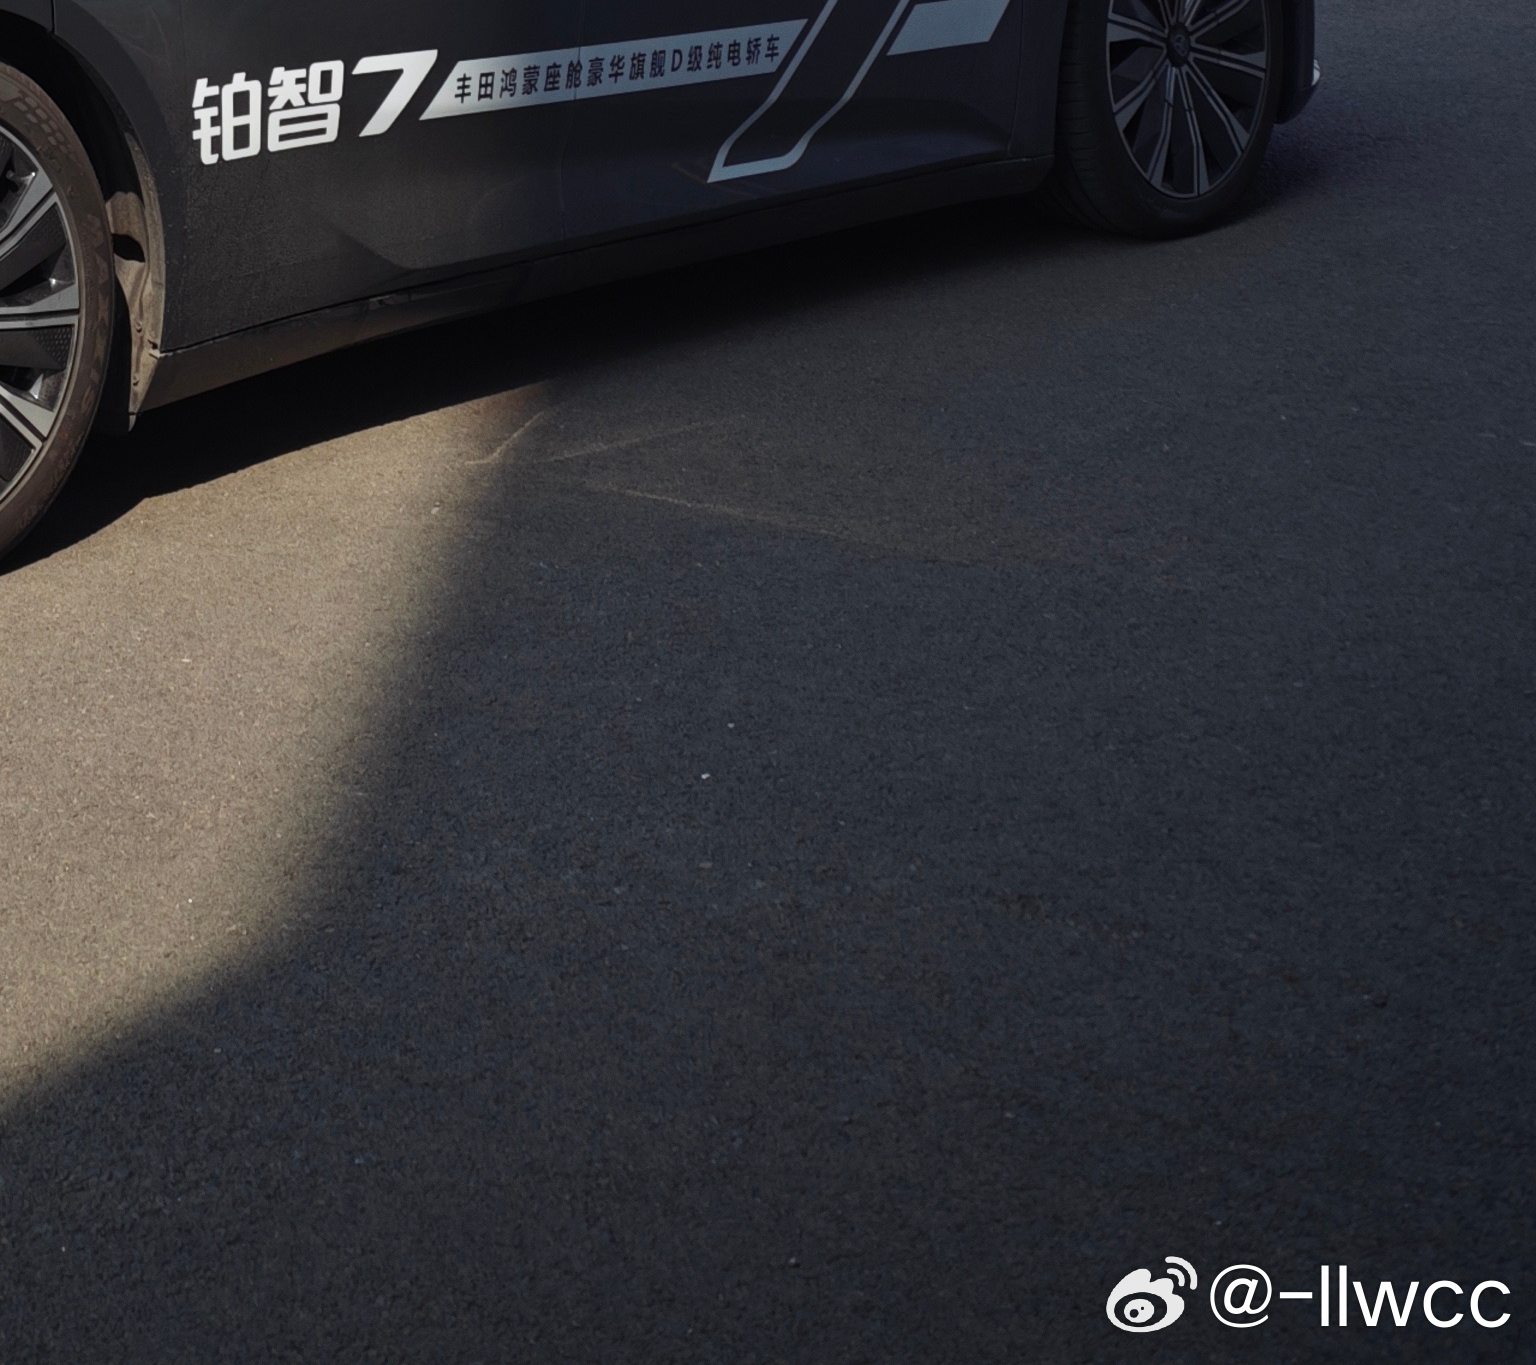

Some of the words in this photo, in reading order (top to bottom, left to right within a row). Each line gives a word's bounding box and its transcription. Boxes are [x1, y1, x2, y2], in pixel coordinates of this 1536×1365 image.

[191, 48, 439, 166] 铂智7
[454, 33, 782, 104] 丰田鸿蒙座舱豪华旗舰D级纯电轿车
